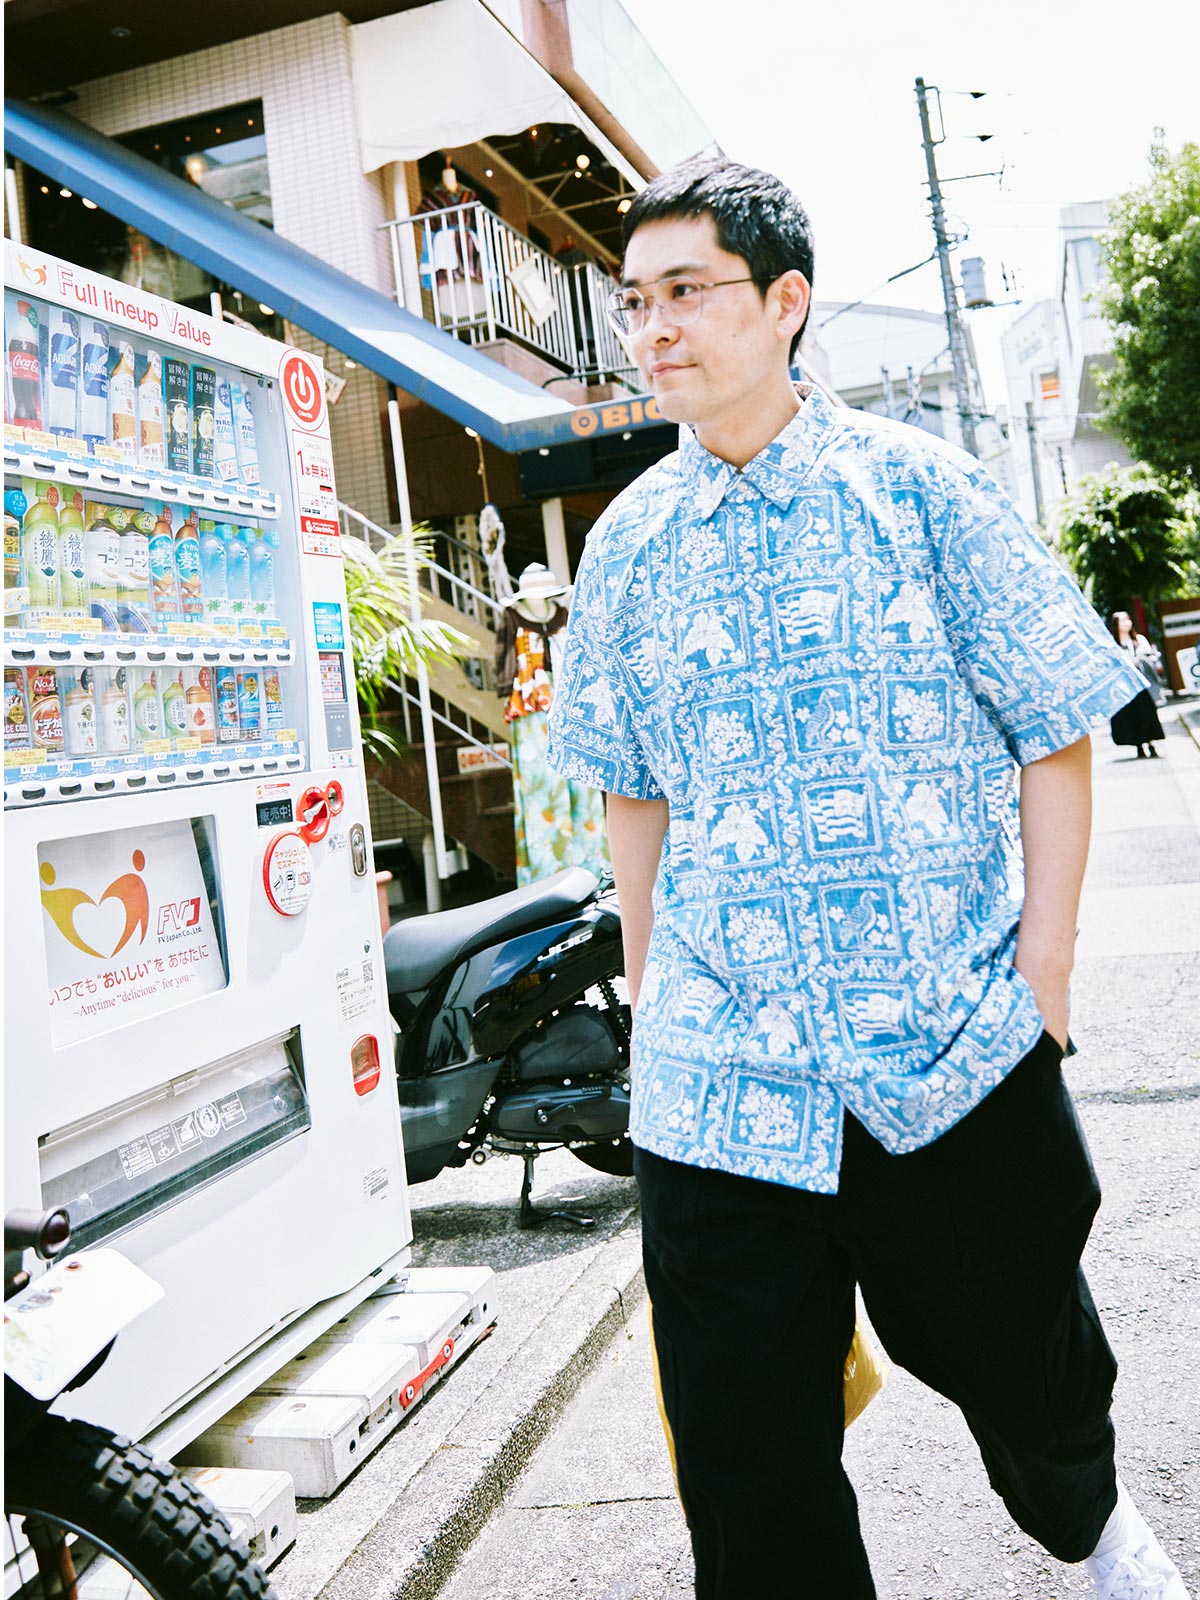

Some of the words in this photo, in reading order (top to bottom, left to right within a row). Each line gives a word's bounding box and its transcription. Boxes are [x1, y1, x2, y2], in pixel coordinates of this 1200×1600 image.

[56, 264, 98, 307] Full
[103, 289, 159, 330] lineup
[161, 303, 212, 346] Value
[259, 804, 288, 822] 販売中
[157, 896, 201, 936] FVJ
[165, 932, 183, 943] Japan
[537, 929, 593, 962] JOG
[168, 944, 209, 969] あなたに
[162, 977, 174, 991] for
